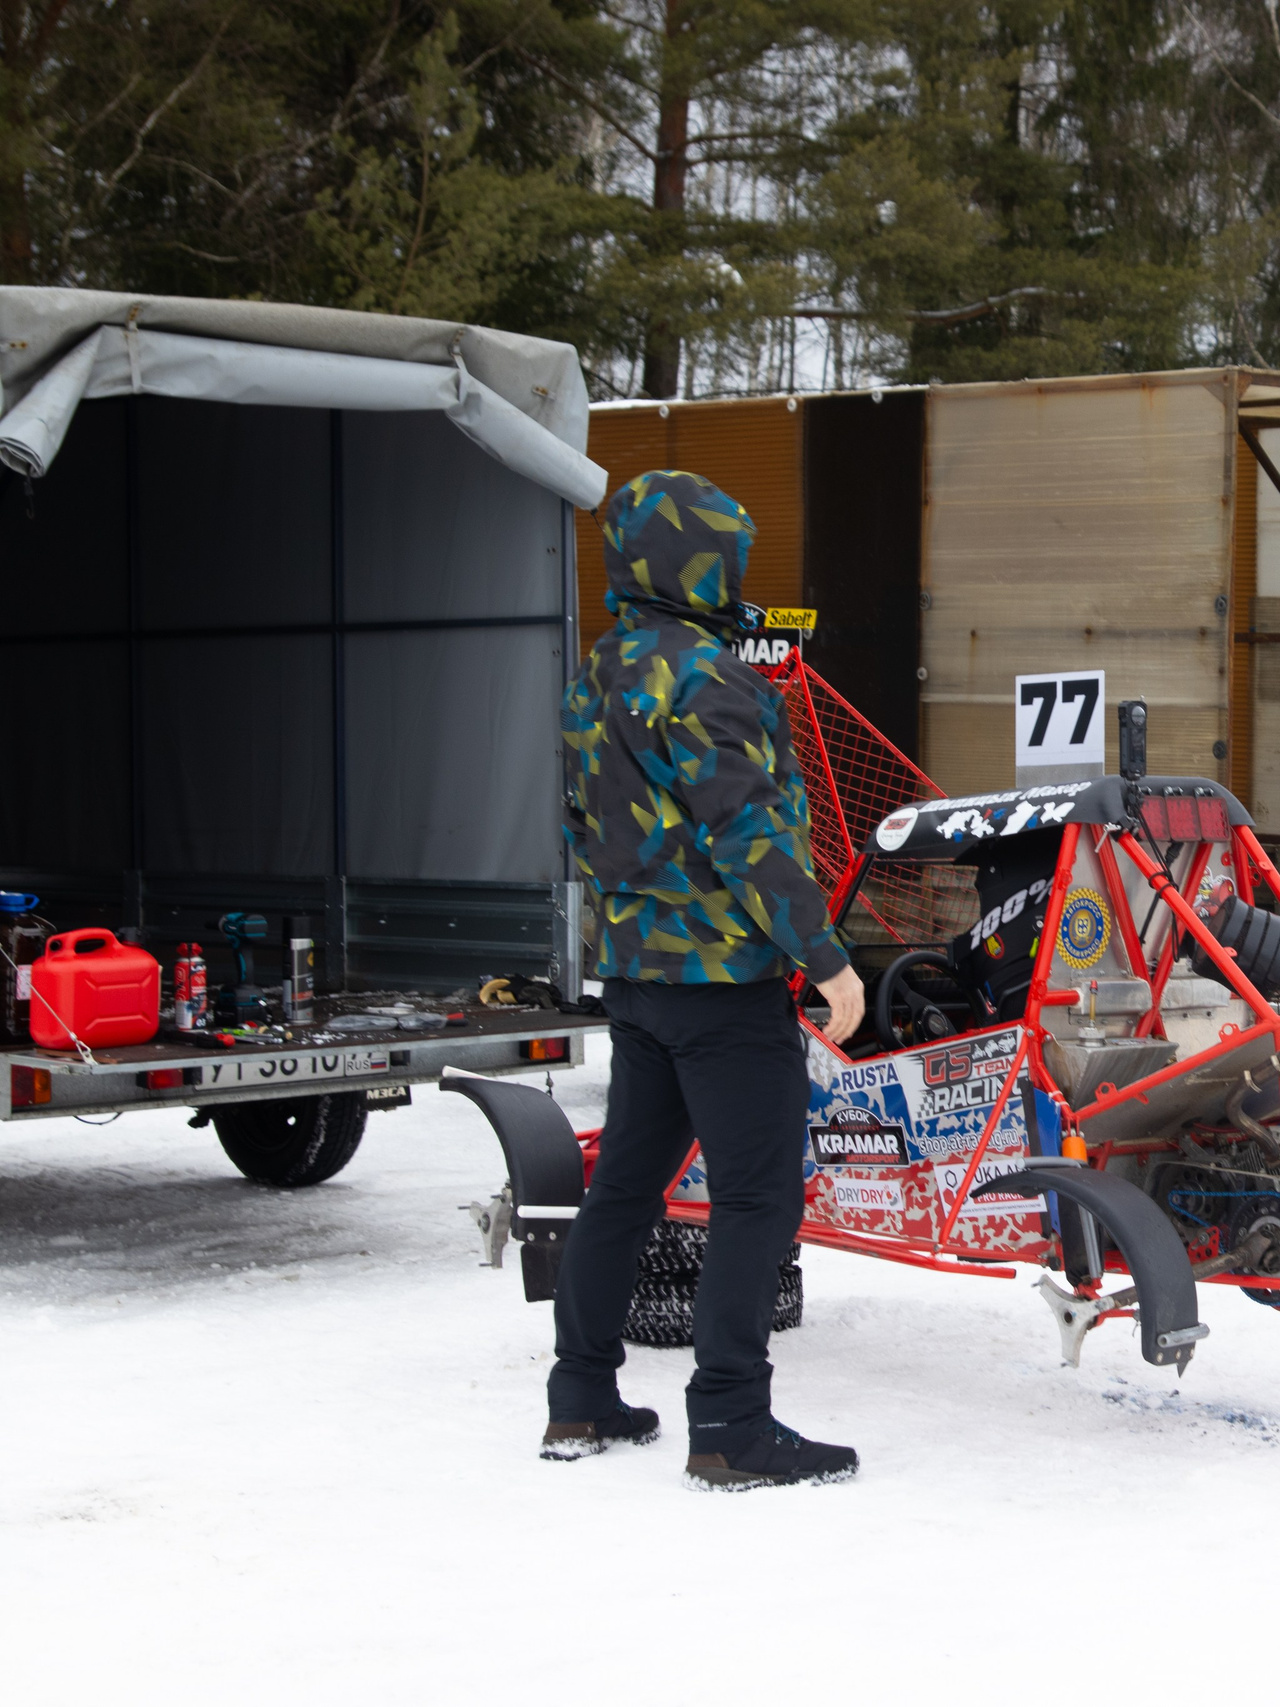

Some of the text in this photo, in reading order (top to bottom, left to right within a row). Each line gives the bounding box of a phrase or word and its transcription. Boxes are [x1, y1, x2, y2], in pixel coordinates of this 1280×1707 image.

[770, 610, 812, 627] Sabelt
[732, 638, 790, 664] MAR
[1020, 678, 1100, 747] 77
[1065, 899, 1102, 919] АВТОКРОСС
[346, 1059, 370, 1071] RUS
[840, 1063, 898, 1092] RUSTA
[836, 1109, 871, 1125] КУБОК
[817, 1133, 900, 1154] KRAMAR
[919, 1128, 1020, 1156] shop.at-rang.ru
[846, 1154, 900, 1163] MOTORSPORT
